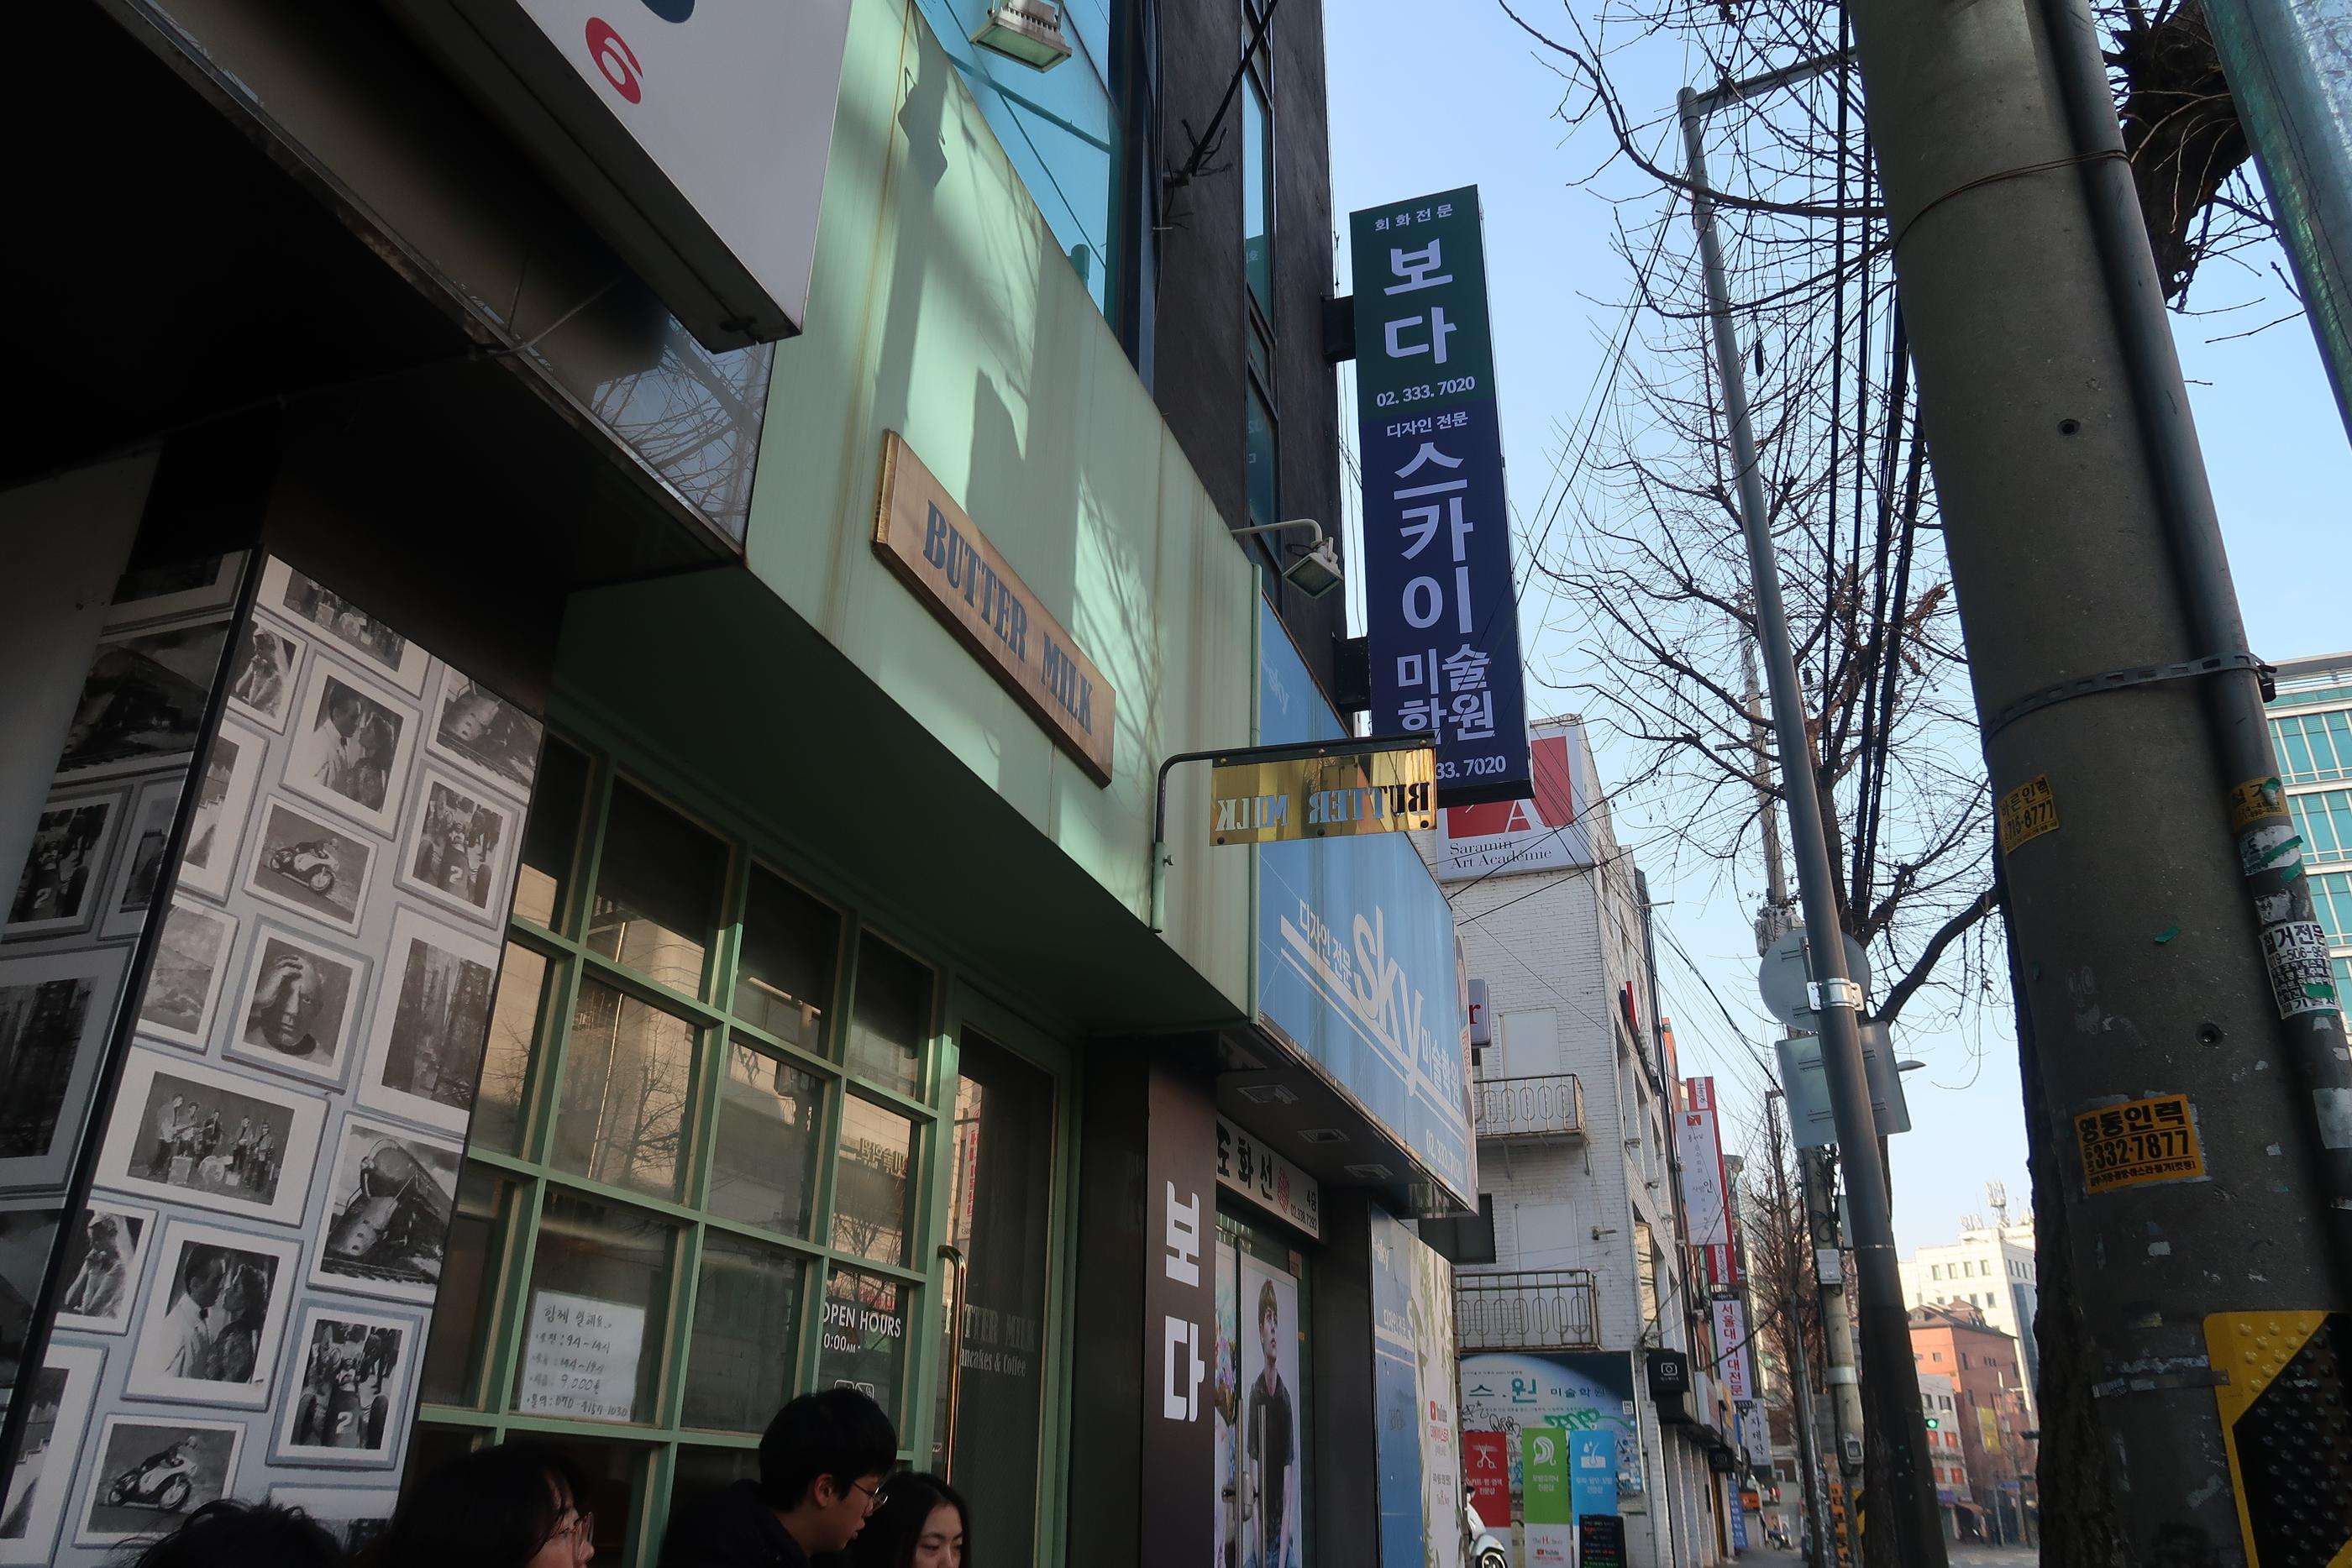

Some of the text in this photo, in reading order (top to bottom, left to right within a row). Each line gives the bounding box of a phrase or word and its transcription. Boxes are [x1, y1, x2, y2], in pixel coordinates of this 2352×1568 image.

[1383, 238, 1457, 364] 보다
[1437, 375, 1475, 396] 7020
[1386, 411, 1468, 438] 디자인 전문
[1394, 442, 1474, 634] 스카이
[922, 499, 1093, 736] BUTTER MILK
[1396, 642, 1492, 695] 미술
[1397, 690, 1496, 745] 학원
[1436, 754, 1507, 780] 33. 7020
[1449, 837, 1515, 856] Saramin
[1450, 844, 1553, 870] Art Académie
[450, 867, 463, 884] 2
[1299, 899, 1331, 967] 디자인
[1332, 936, 1352, 992] 전문
[1420, 1025, 1462, 1111] 미술학원
[2079, 1101, 2186, 1144] 영동인력
[1306, 1189, 1317, 1212] 4층
[1163, 1180, 1205, 1423] 보다
[823, 1301, 901, 1338] OPEN HOURS
[1006, 1314, 1036, 1351] MILK
[823, 1332, 856, 1354] 0:00AM
[959, 1347, 1026, 1378] ancakes & Coffee
[1550, 1386, 1607, 1398] 미술학원
[336, 1412, 353, 1434] 2
